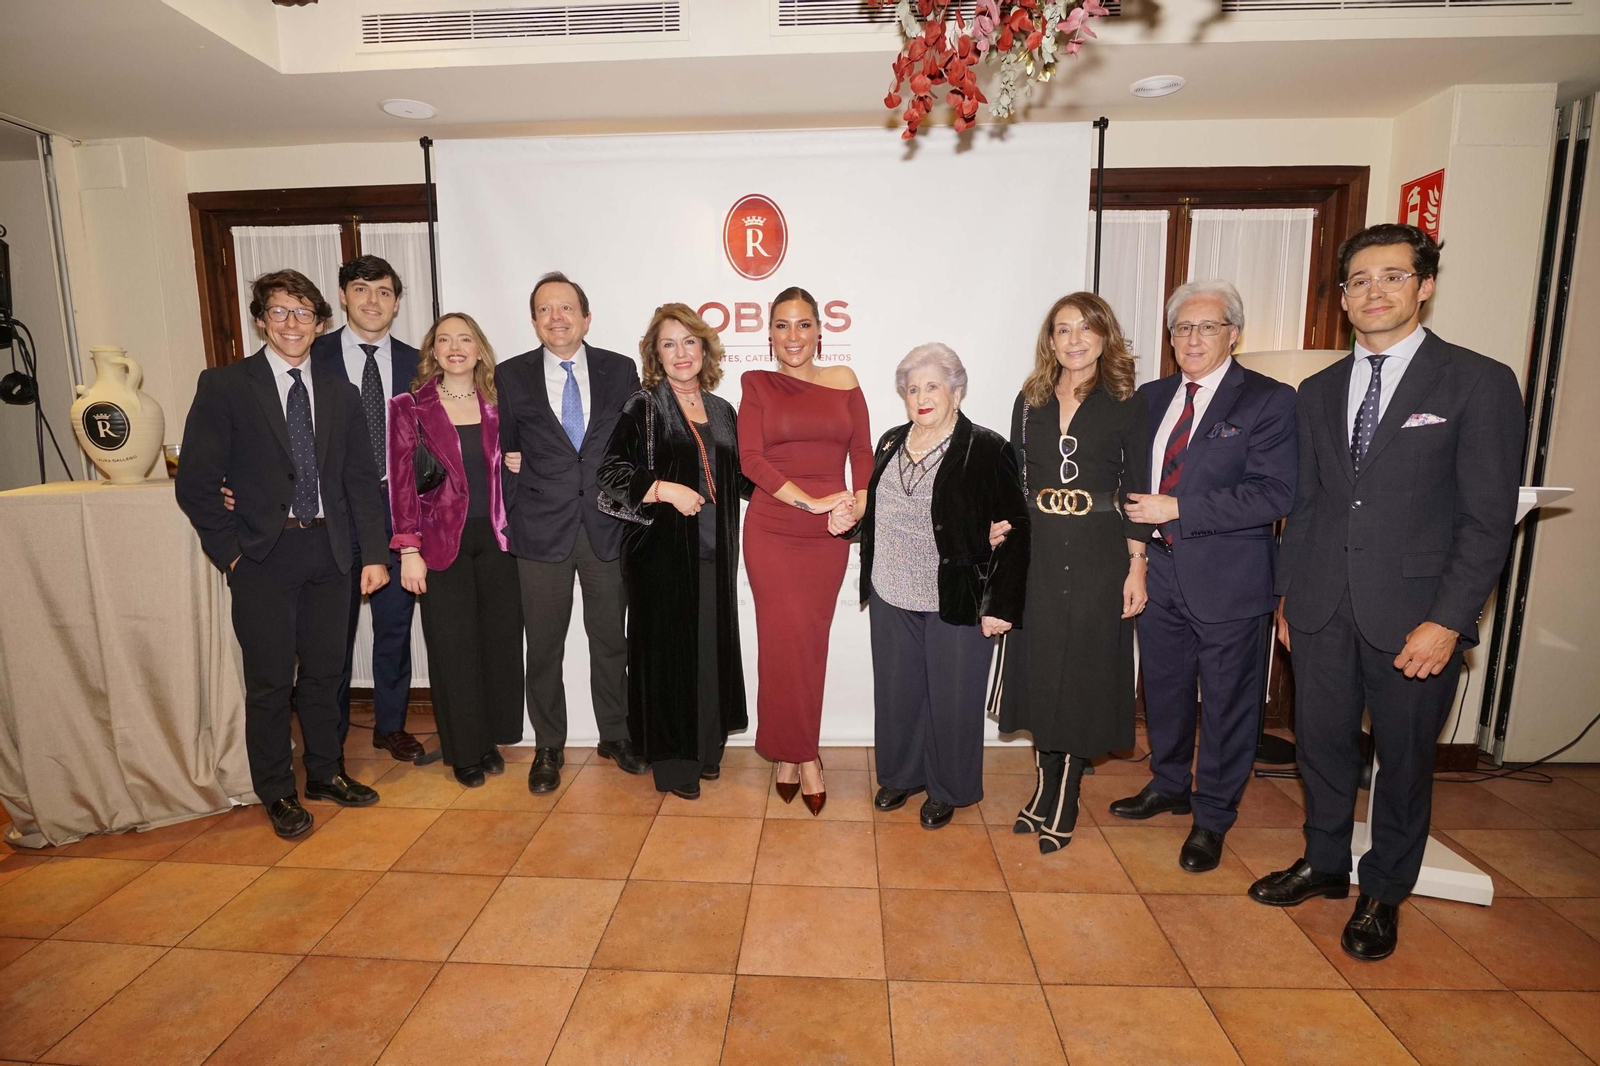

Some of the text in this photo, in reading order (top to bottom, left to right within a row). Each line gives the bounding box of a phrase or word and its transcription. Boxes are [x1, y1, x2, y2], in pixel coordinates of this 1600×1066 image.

[745, 228, 772, 257] R
[813, 353, 852, 362] VENTOS
[97, 420, 120, 438] R
